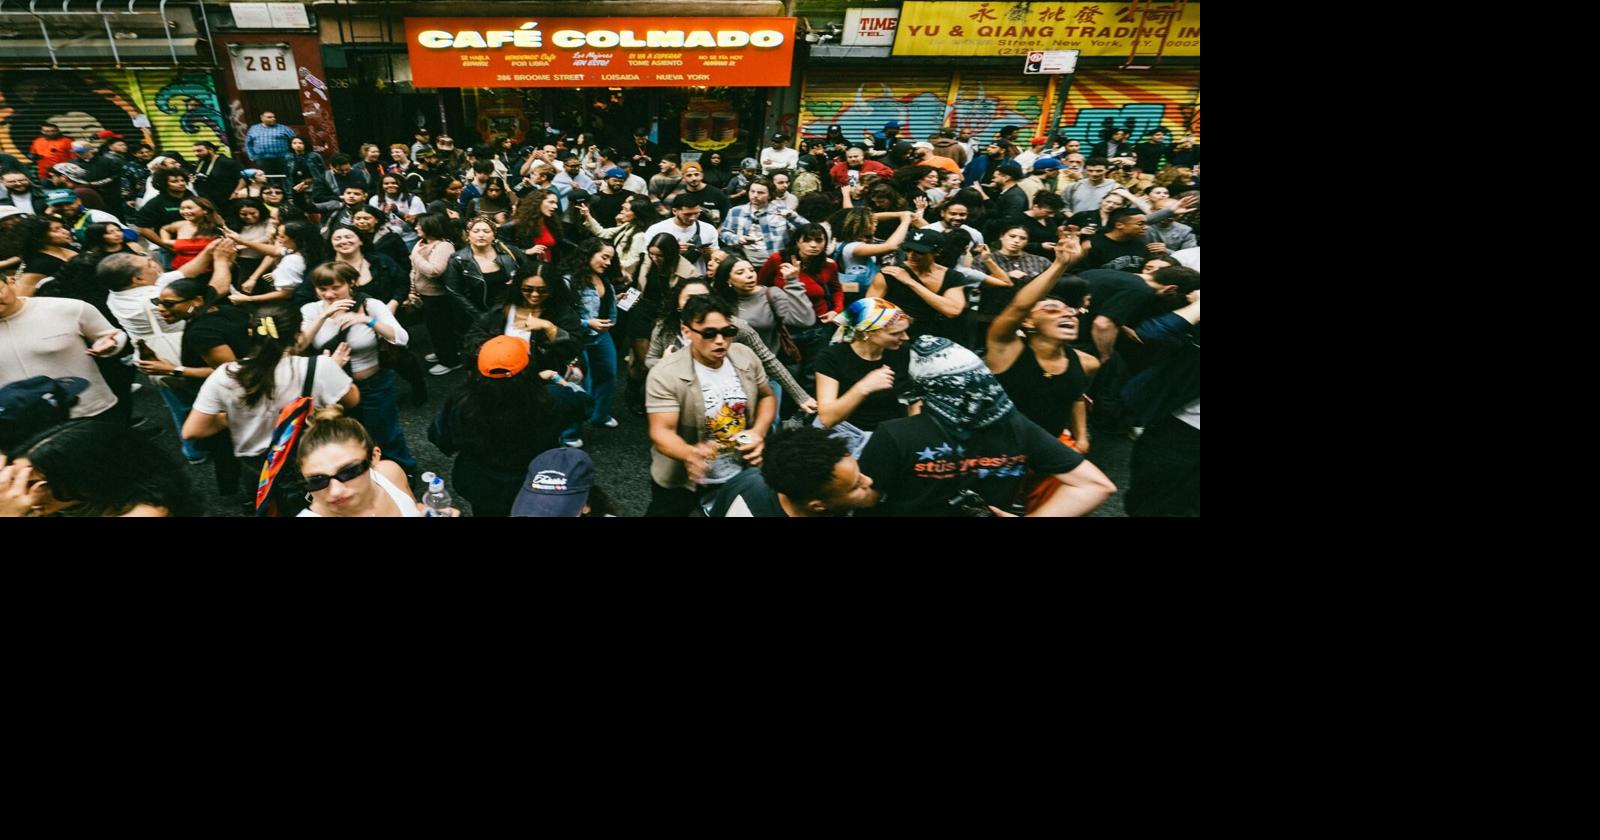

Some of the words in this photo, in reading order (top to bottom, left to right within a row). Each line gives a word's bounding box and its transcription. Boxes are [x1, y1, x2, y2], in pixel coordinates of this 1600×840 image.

[859, 17, 898, 31] TIME
[418, 22, 543, 49] CAFÉ
[552, 29, 784, 48] COLMADO
[908, 25, 940, 37] YU
[949, 25, 964, 37] &
[977, 25, 1055, 38] QIANG
[1065, 26, 1169, 38] TRADING
[1052, 39, 1081, 47] New
[243, 56, 287, 72] 288
